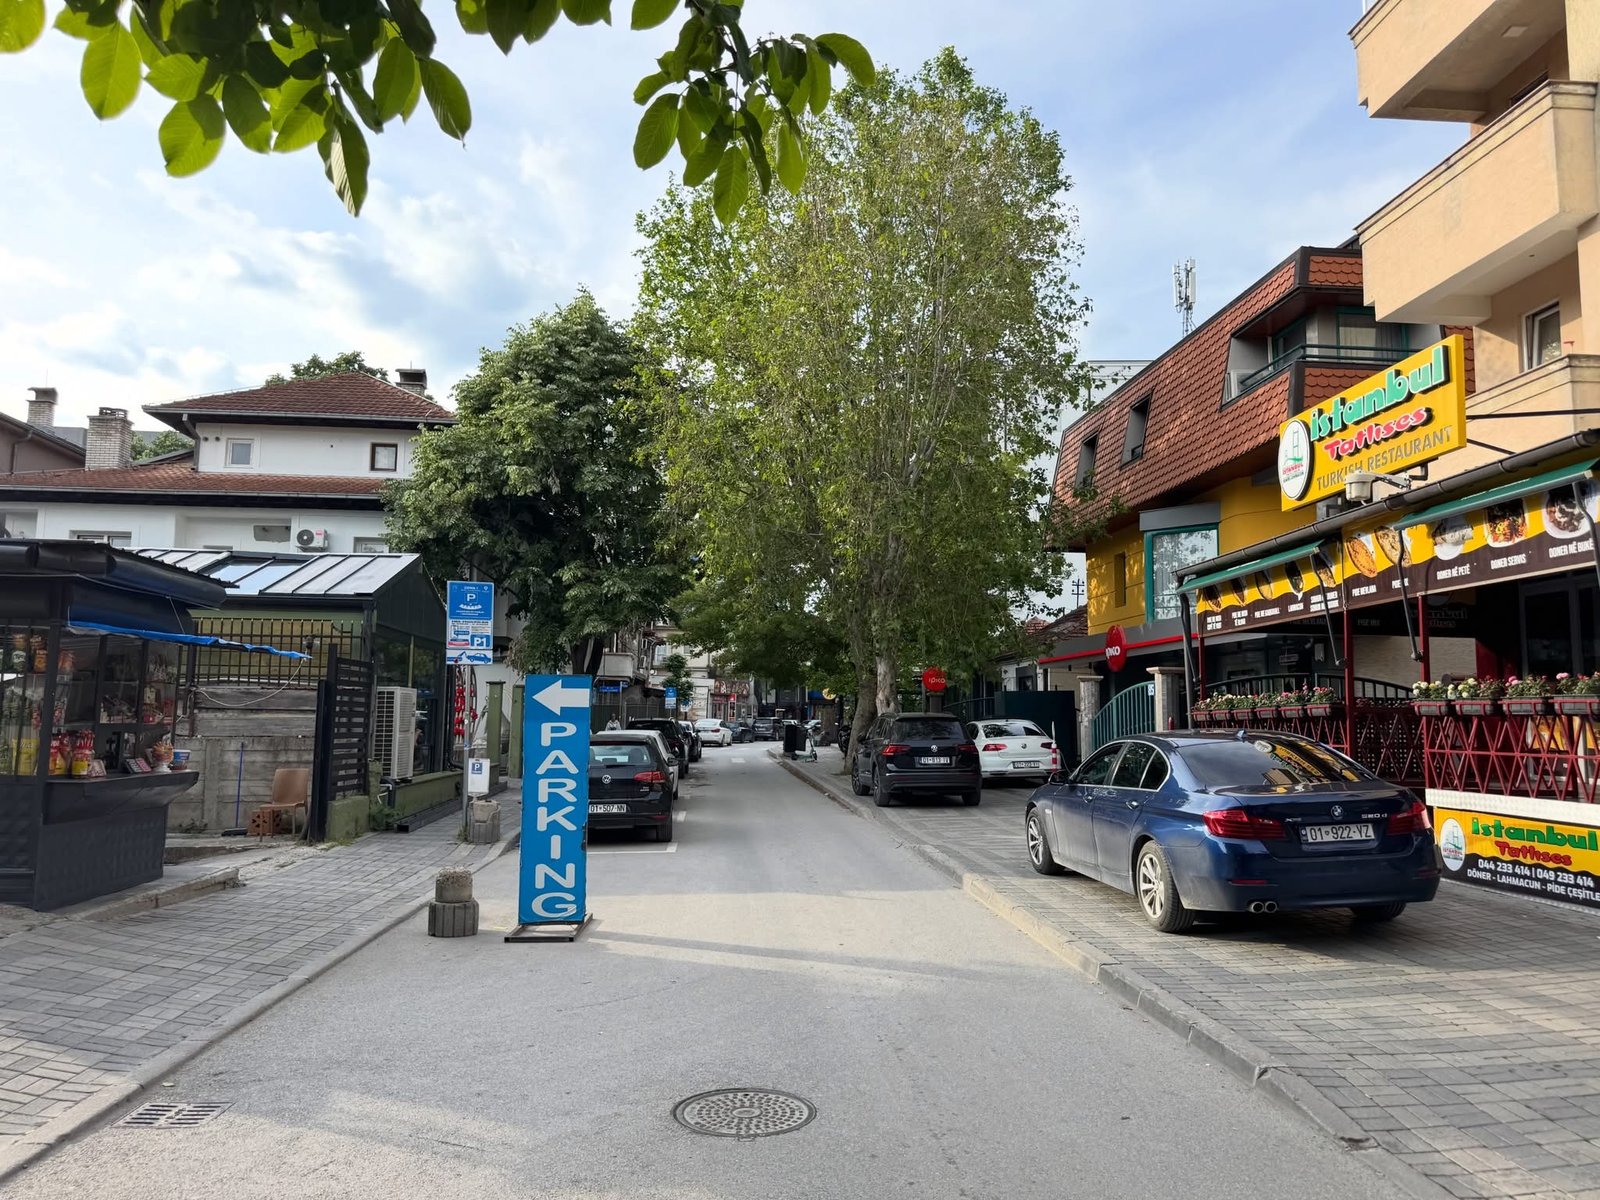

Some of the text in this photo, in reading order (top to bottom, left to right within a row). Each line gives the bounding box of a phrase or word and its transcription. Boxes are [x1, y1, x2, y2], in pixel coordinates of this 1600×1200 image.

[1367, 425, 1453, 472] RESTAURANT
[474, 637, 487, 647] P1
[531, 722, 579, 919] PARKING
[1467, 867, 1492, 881] DÖNER
[1497, 874, 1541, 890] LAHMACUN
[1478, 858, 1495, 871] 044
[1496, 862, 1513, 874] 233
[1514, 864, 1531, 877] 414
[1536, 868, 1555, 881] 049
[1556, 872, 1575, 884] 233
[1576, 875, 1595, 888] 414
